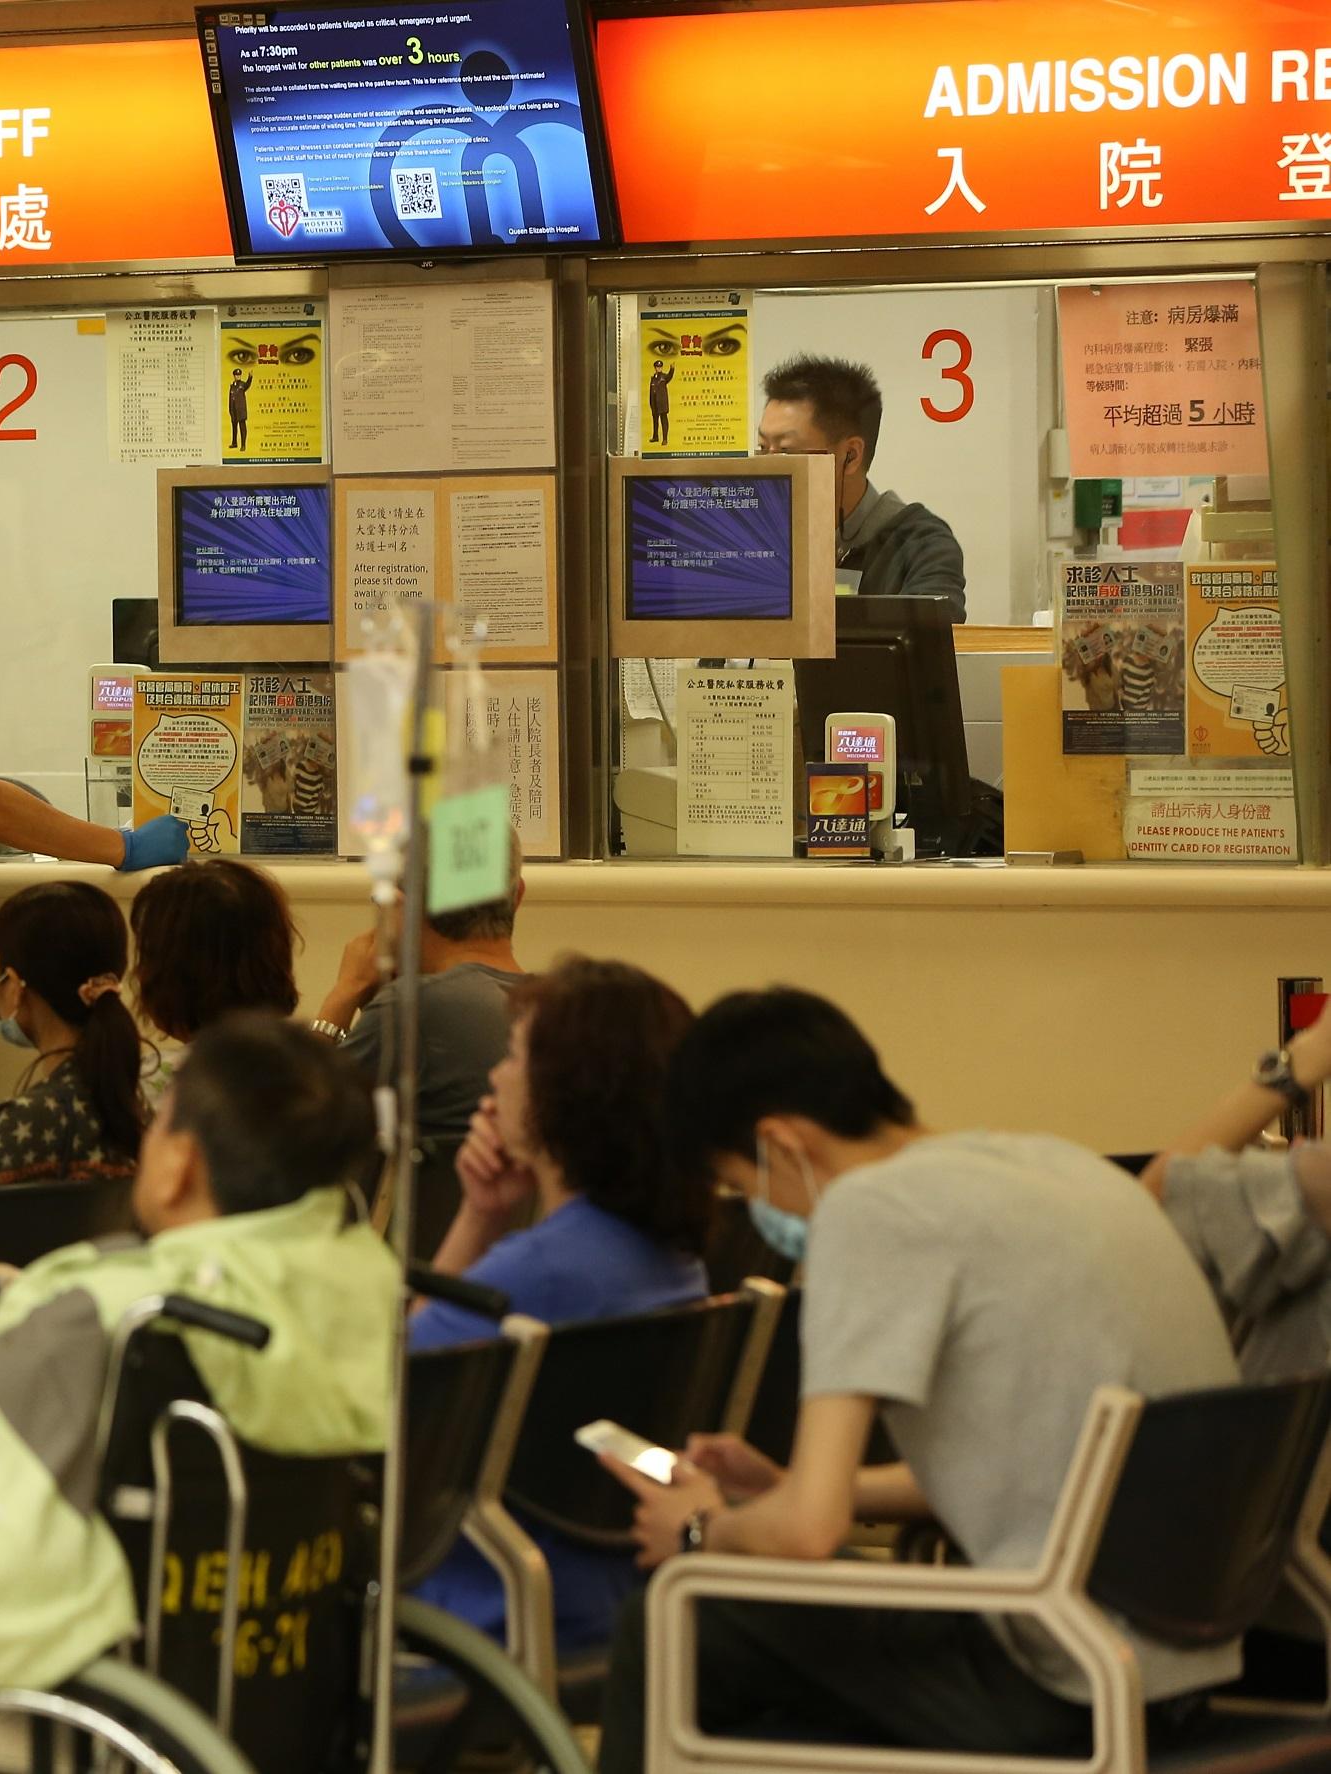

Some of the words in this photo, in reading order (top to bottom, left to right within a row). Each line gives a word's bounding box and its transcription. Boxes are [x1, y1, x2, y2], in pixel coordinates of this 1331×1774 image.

[235, 26, 257, 35] Priority
[258, 25, 269, 33] will
[270, 24, 278, 32] be
[279, 23, 308, 32] accorded
[317, 21, 342, 31] patients
[343, 19, 365, 29] triaged
[375, 18, 398, 27] critical,
[399, 16, 434, 26] emergency
[435, 15, 448, 23] and
[449, 14, 472, 23] urgent.
[240, 50, 251, 58] As
[251, 50, 259, 58] at
[259, 45, 298, 58] 7:30pm
[243, 64, 254, 73] the
[255, 63, 281, 73] longest
[282, 62, 297, 71] wait
[298, 61, 308, 70] for
[309, 60, 329, 69] other
[331, 59, 361, 70] patients
[379, 55, 403, 66] over
[406, 37, 424, 65] 3
[427, 52, 463, 64] hours.
[924, 51, 1246, 119] ADMISSION
[508, 227, 528, 235] Queen
[556, 225, 580, 235] Hospital
[1167, 304, 1239, 325] 病房爆滿
[1184, 337, 1213, 353] 緊張
[919, 328, 975, 423] 3
[1104, 403, 1183, 428] 平均超過
[1189, 399, 1205, 422] 5
[1213, 401, 1256, 426] 小時
[214, 496, 297, 507] 病人登記所需要出示的
[354, 563, 376, 573] After
[377, 563, 429, 575] registration,
[1066, 566, 1138, 584] 求診人士
[354, 576, 381, 586] please
[382, 577, 393, 585] sit
[395, 576, 418, 585] down
[354, 590, 377, 598] await
[400, 590, 423, 598] name
[354, 602, 363, 610] to
[250, 677, 311, 694] 求診人士
[687, 679, 785, 690] 公立醫院私家服務收費
[838, 736, 877, 748] 八達通
[529, 696, 542, 820] 老人院長者及陪同
[1151, 802, 1271, 820] 請出示病人身份證
[812, 818, 866, 834] 八達通
[1137, 826, 1171, 836] PLEASE
[1173, 827, 1220, 837] PRODUCE
[1221, 828, 1238, 837] THE
[1241, 828, 1285, 838] PATIENT'S
[810, 835, 867, 843] OCTOPUS
[1171, 843, 1199, 853] CARD
[1202, 844, 1221, 854] FOR
[1224, 844, 1291, 855] REGISTRATION
